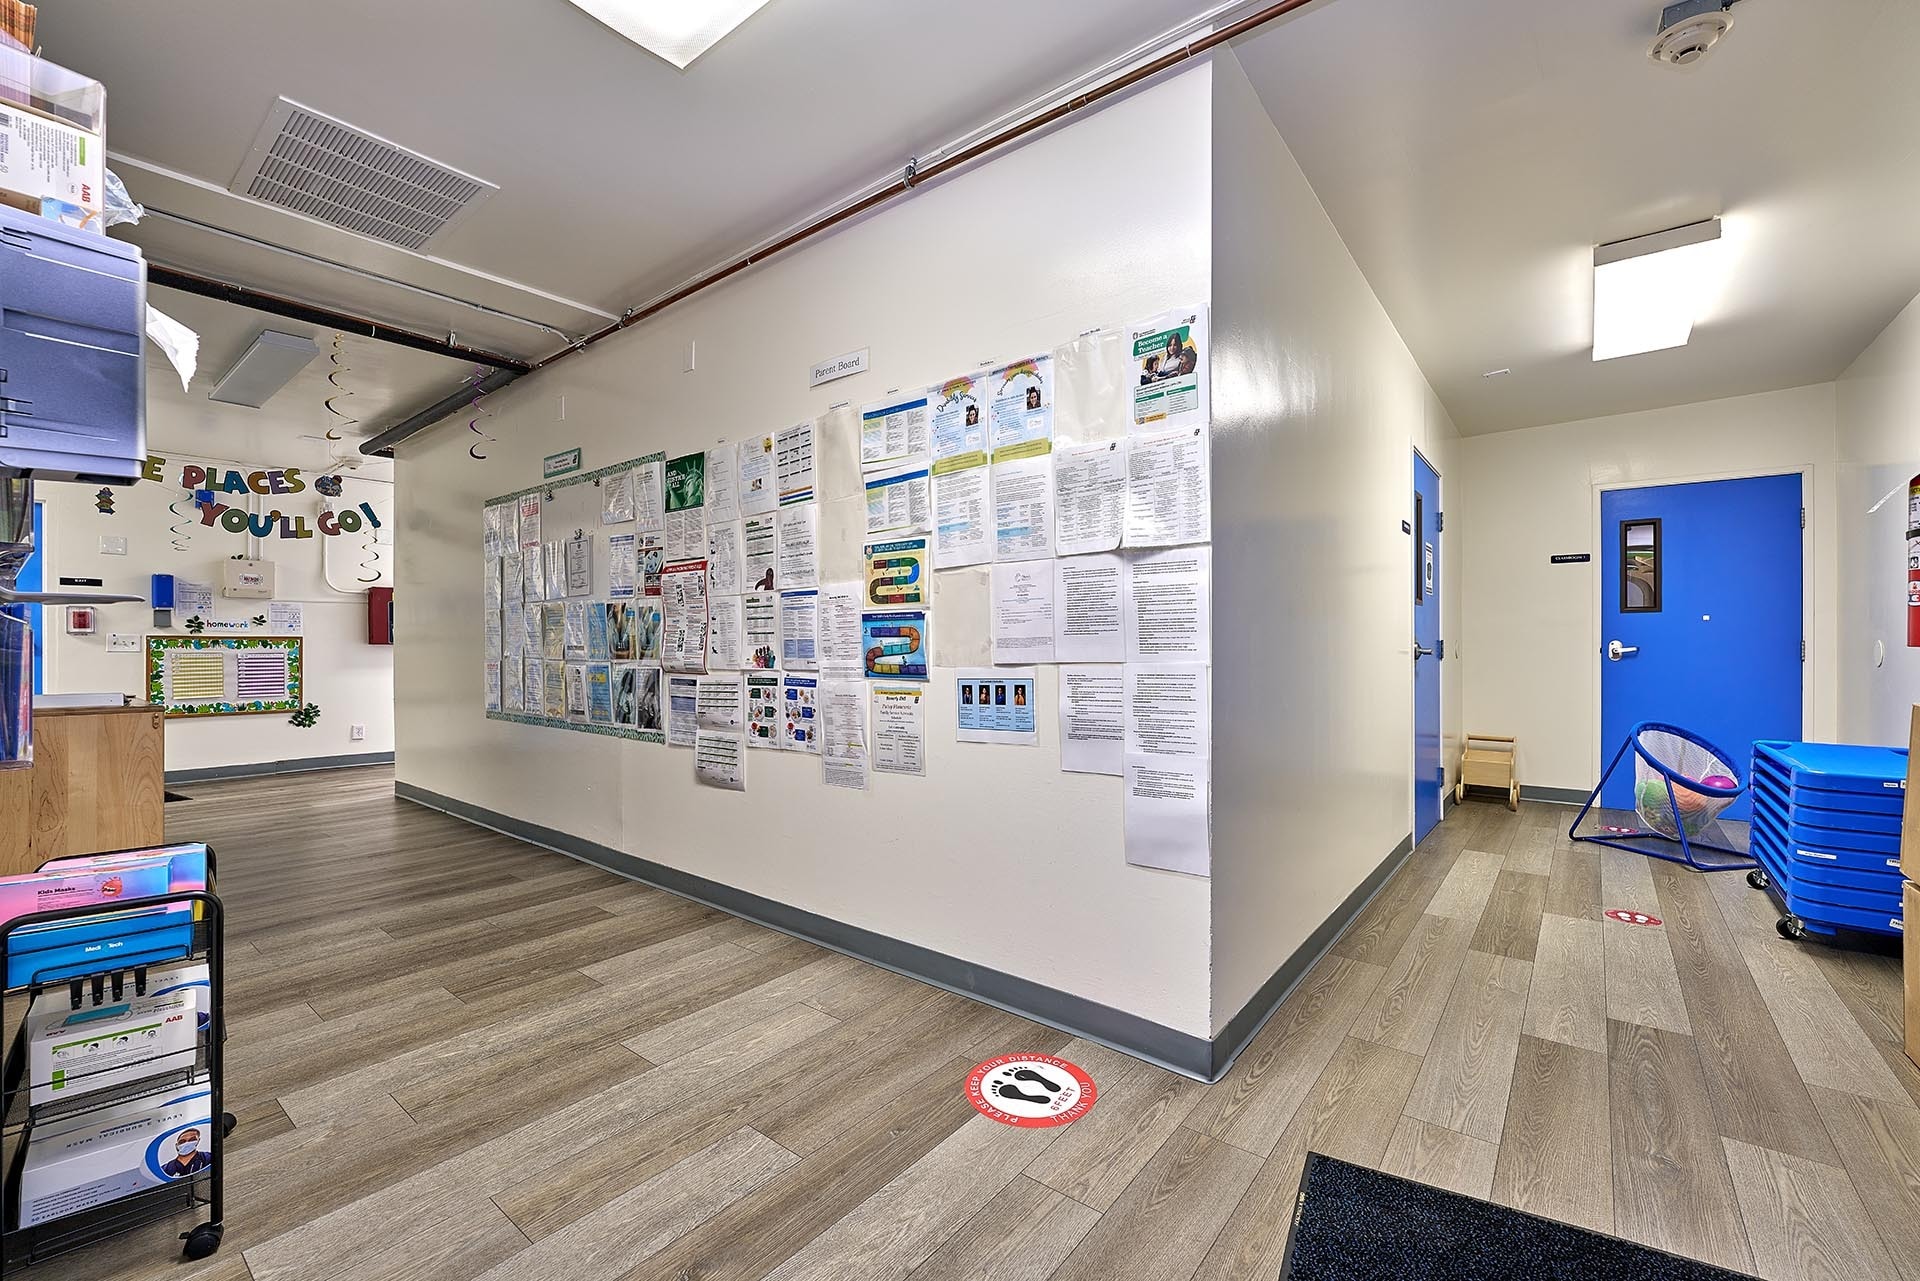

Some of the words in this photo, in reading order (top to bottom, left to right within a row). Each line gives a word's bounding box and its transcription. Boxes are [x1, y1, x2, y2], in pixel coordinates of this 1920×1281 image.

[81, 183, 91, 203] AAB
[1137, 335, 1162, 348] Become
[1138, 341, 1165, 354] Teacher
[815, 365, 836, 379] Parent
[838, 356, 860, 371] Board
[182, 464, 307, 495] PLACES
[200, 501, 313, 539] YOU'LL
[317, 501, 382, 536] GO!
[206, 619, 249, 629] homework
[85, 945, 101, 953] Medi
[108, 941, 124, 949] Tech
[165, 1014, 184, 1024] AAB
[977, 1059, 1005, 1074] YOUR
[1008, 1055, 1068, 1070] DISTANCE
[969, 1076, 981, 1097] KEEP
[1050, 1101, 1088, 1123] THANK
[1080, 1081, 1092, 1099] YOU
[158, 1113, 184, 1123] LEVEL
[975, 1099, 1019, 1123] PLEASE
[99, 1124, 144, 1139] SURGICAL
[66, 1137, 93, 1149] MASK
